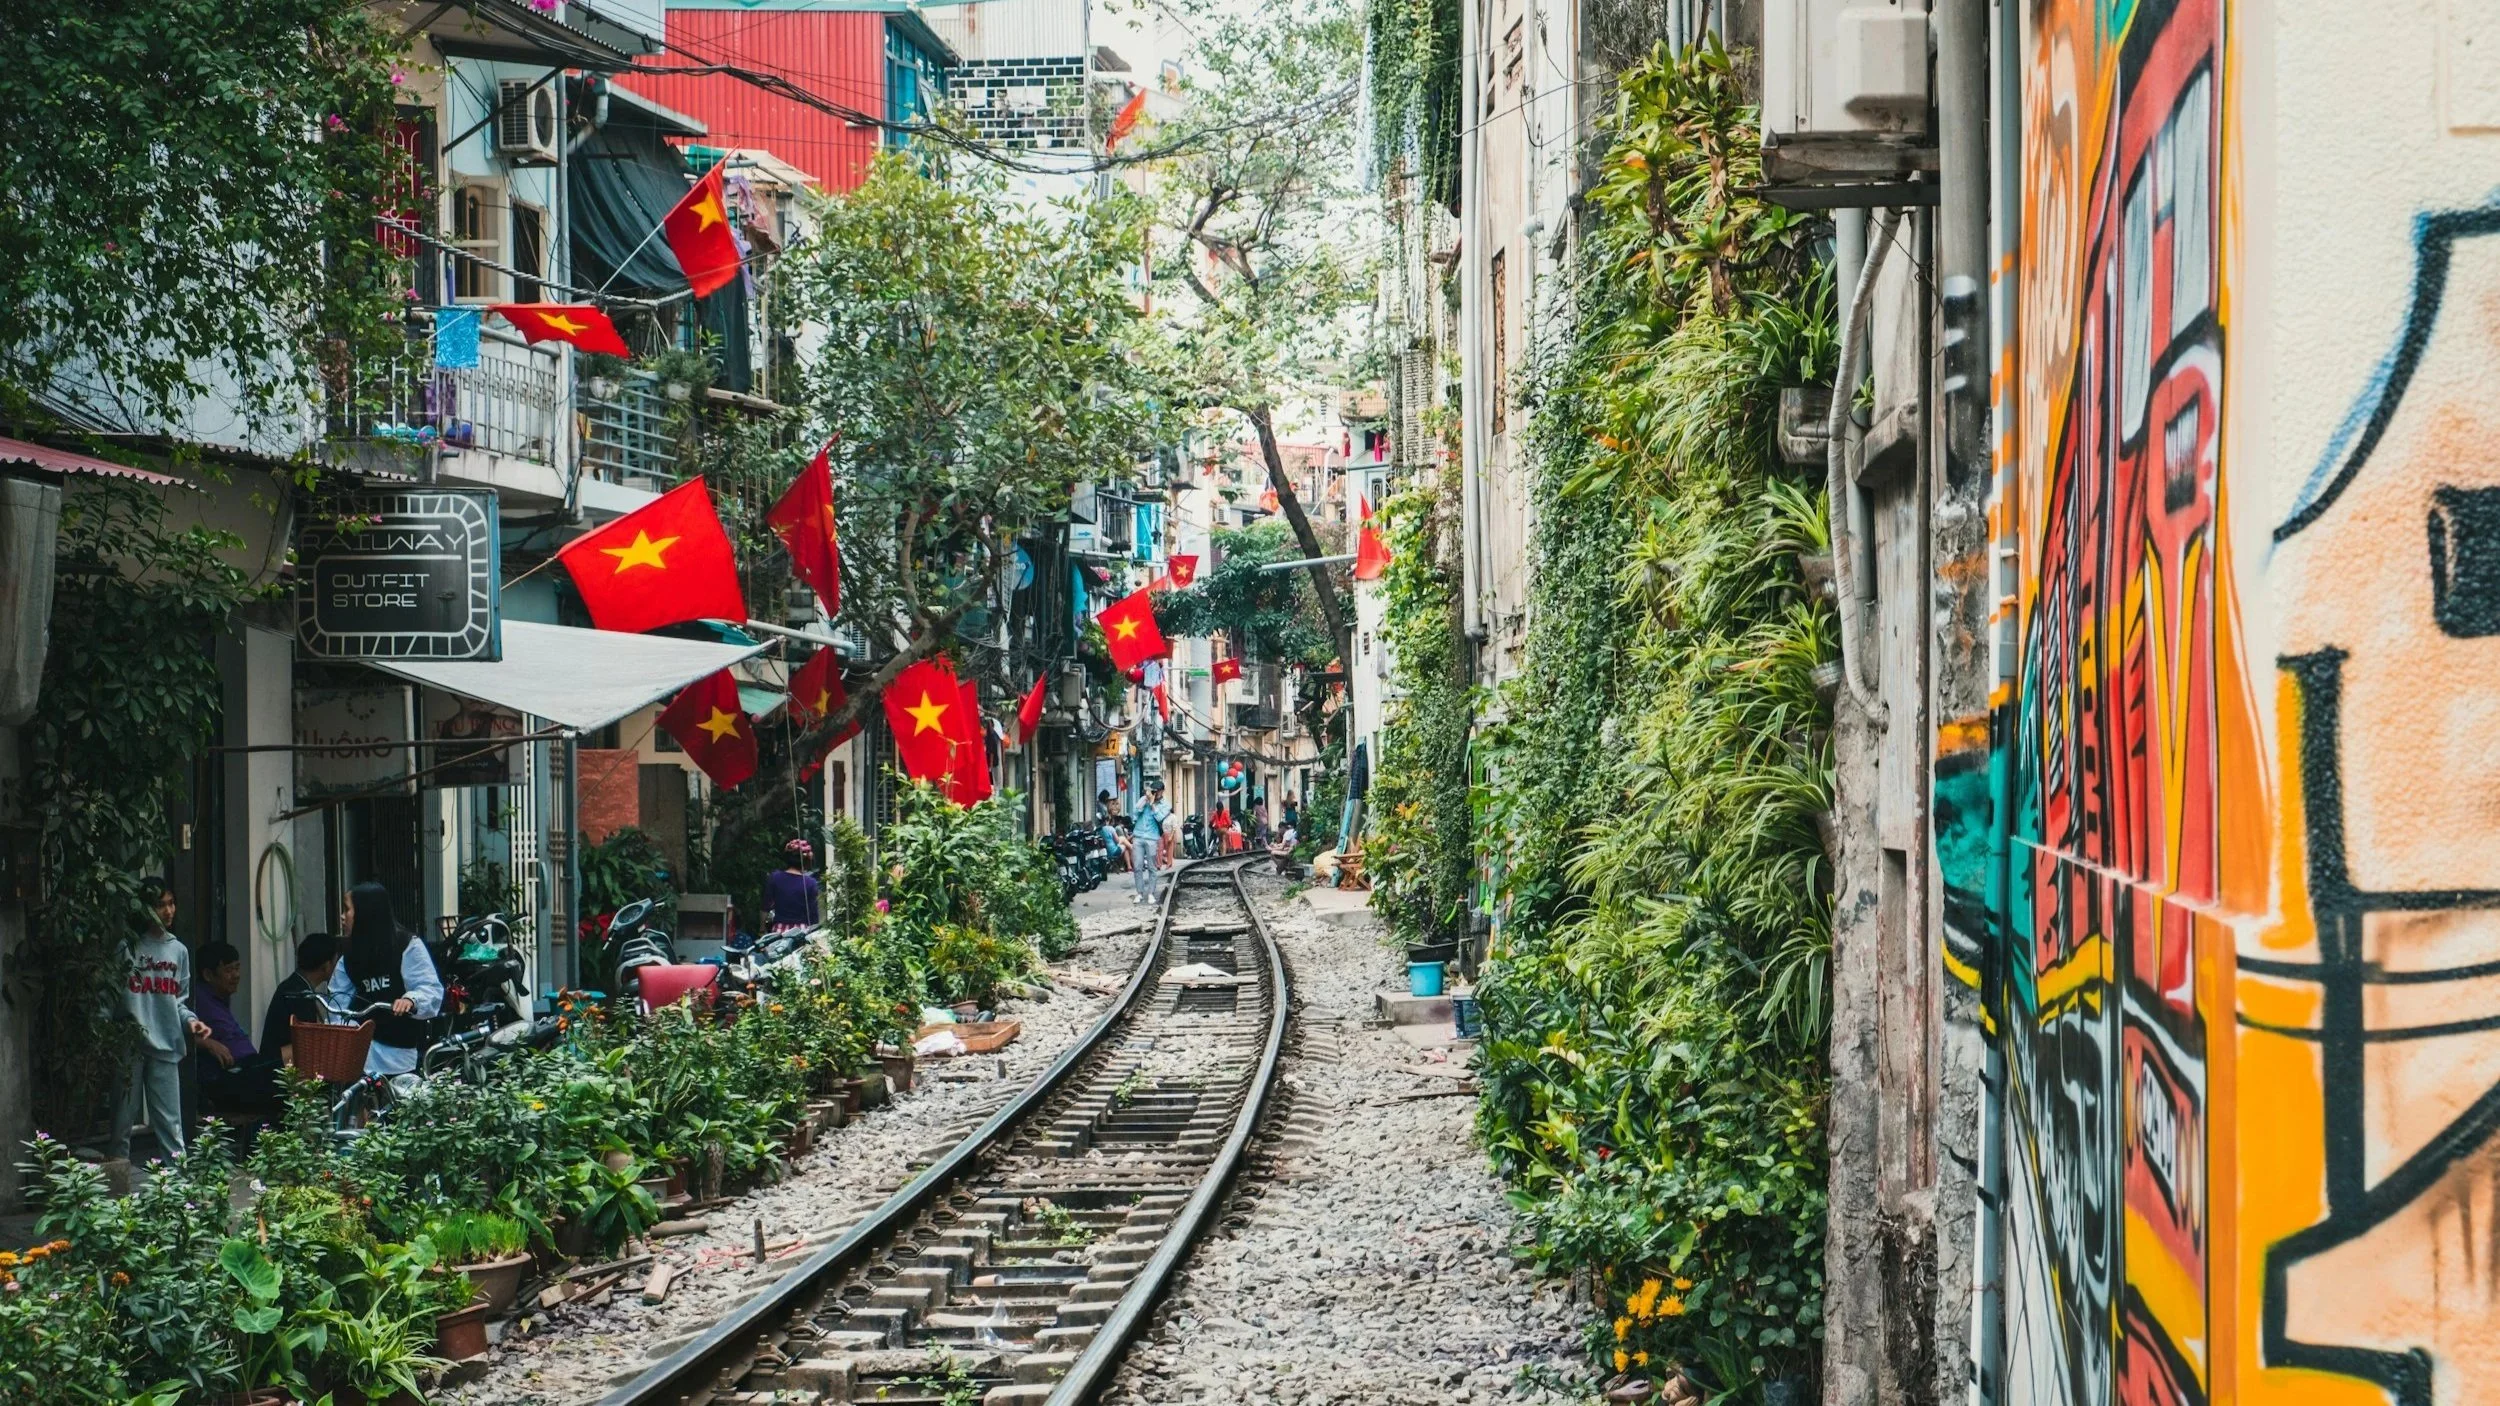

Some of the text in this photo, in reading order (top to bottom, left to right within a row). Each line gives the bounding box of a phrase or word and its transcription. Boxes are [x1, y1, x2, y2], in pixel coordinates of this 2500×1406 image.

[300, 533, 465, 551] RAILWAY
[332, 573, 430, 588] OUTFIT
[332, 593, 418, 608] STORE
